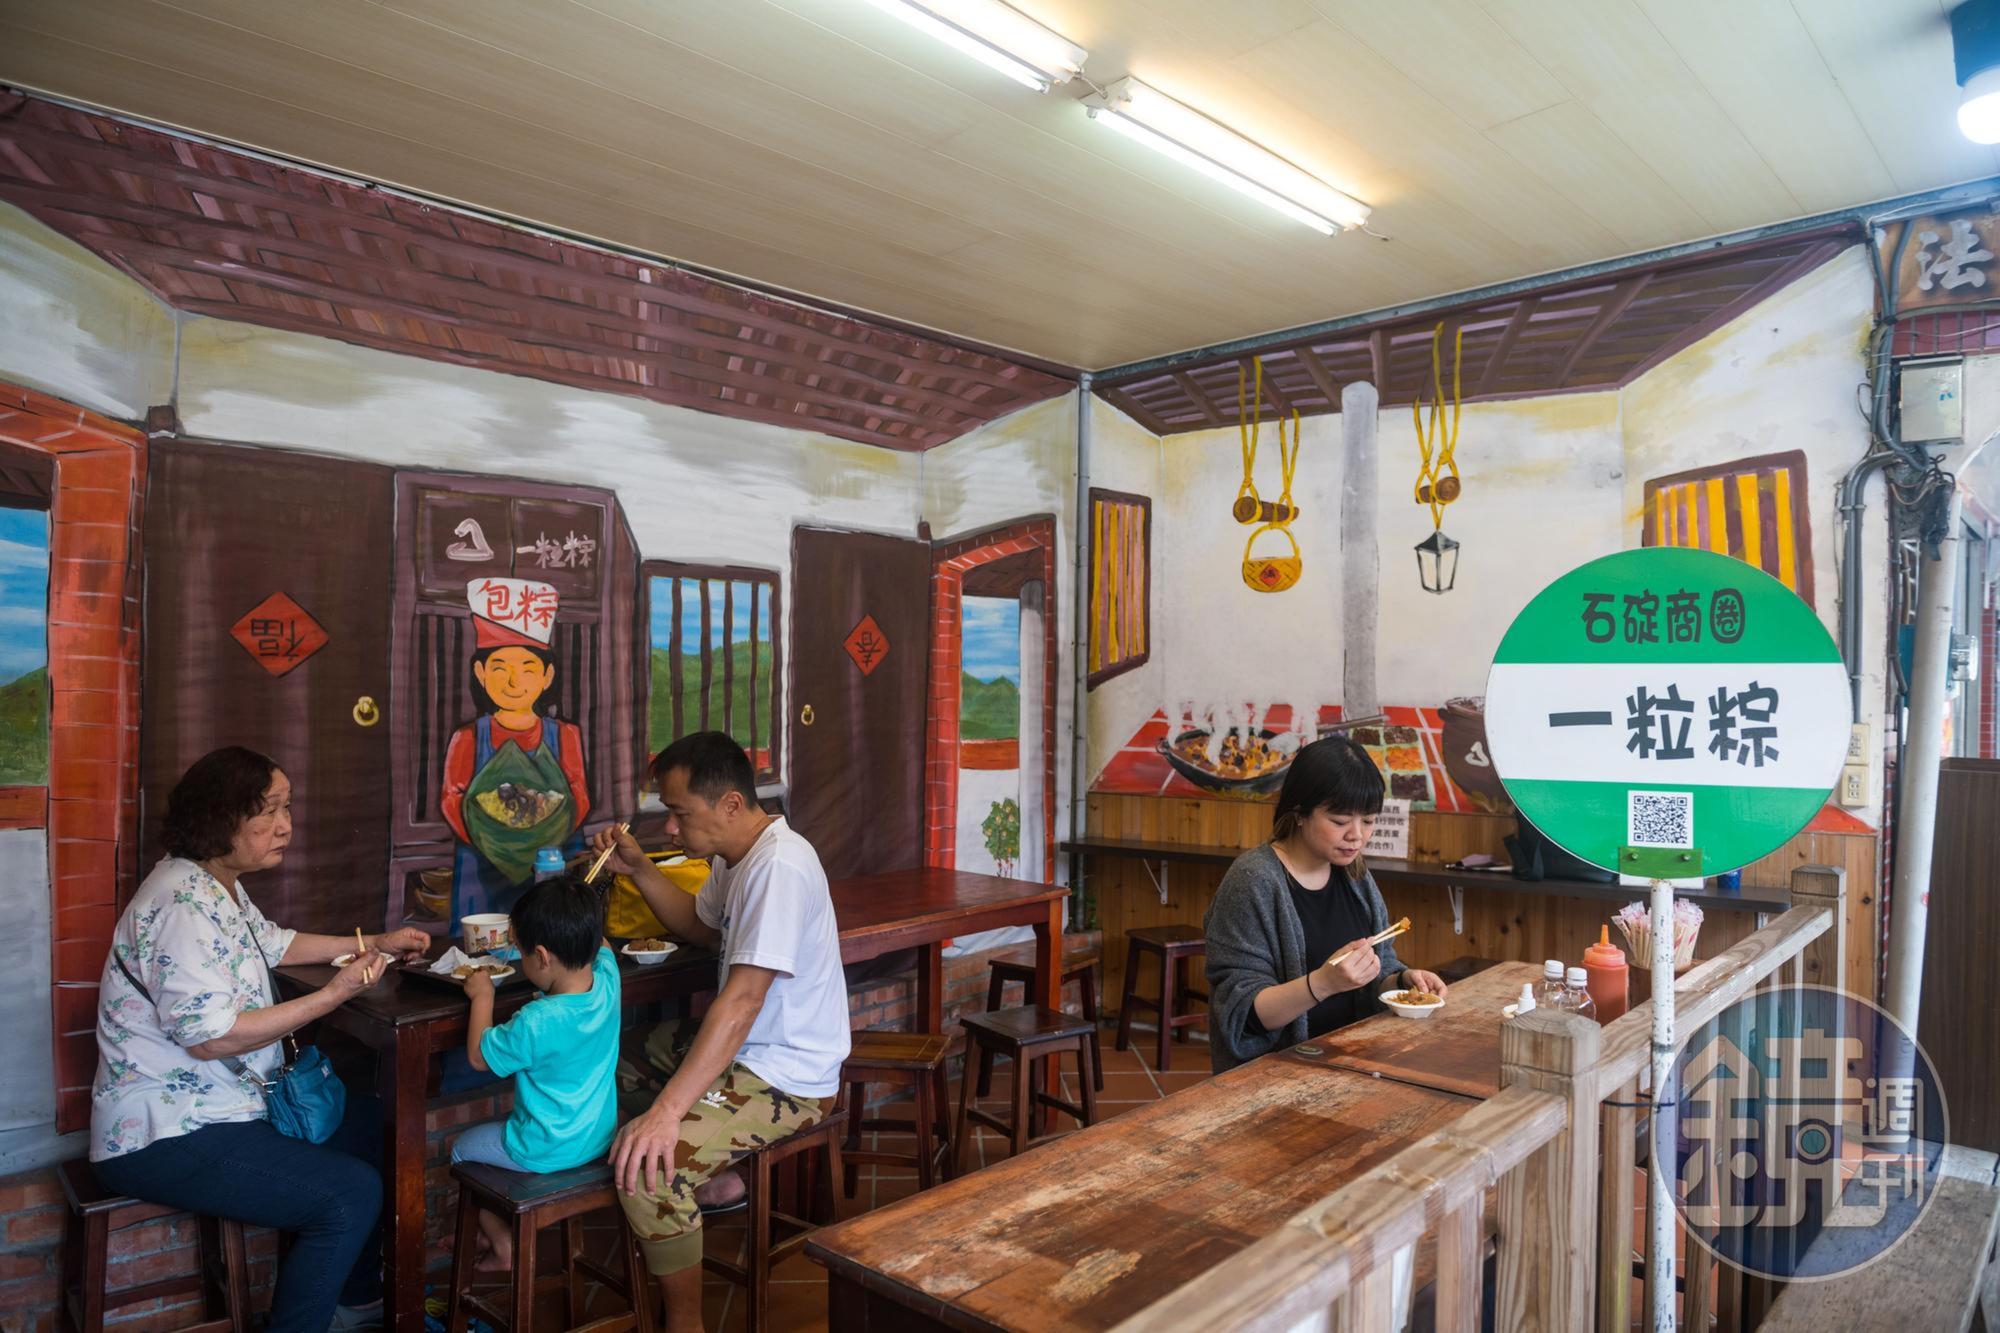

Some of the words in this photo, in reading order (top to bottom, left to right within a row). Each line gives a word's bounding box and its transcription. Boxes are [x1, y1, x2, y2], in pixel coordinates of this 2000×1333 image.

[1915, 219, 1995, 291] 法
[516, 530, 596, 569] 一粒粽
[477, 579, 559, 632] 包粽
[1580, 588, 1745, 645] 石碇商圈
[251, 617, 305, 662] 福
[1548, 680, 1780, 768] 一粒粽
